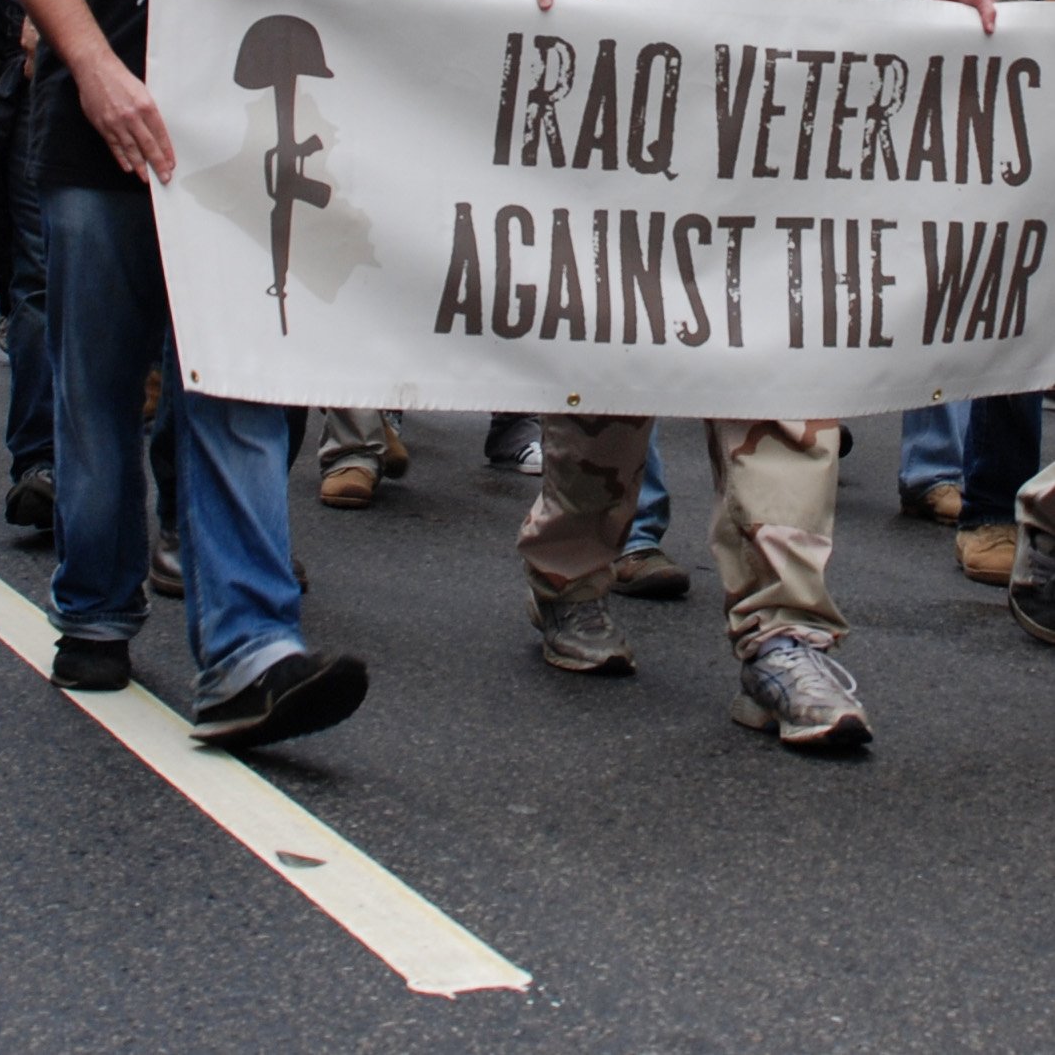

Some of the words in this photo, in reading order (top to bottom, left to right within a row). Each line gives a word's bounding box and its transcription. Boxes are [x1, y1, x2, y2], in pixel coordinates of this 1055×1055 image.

[492, 32, 682, 181] IRAQ
[714, 44, 1041, 187] VETERANS
[433, 202, 756, 348] AGAINST
[775, 217, 897, 348] THE
[923, 219, 1048, 344] WAR
